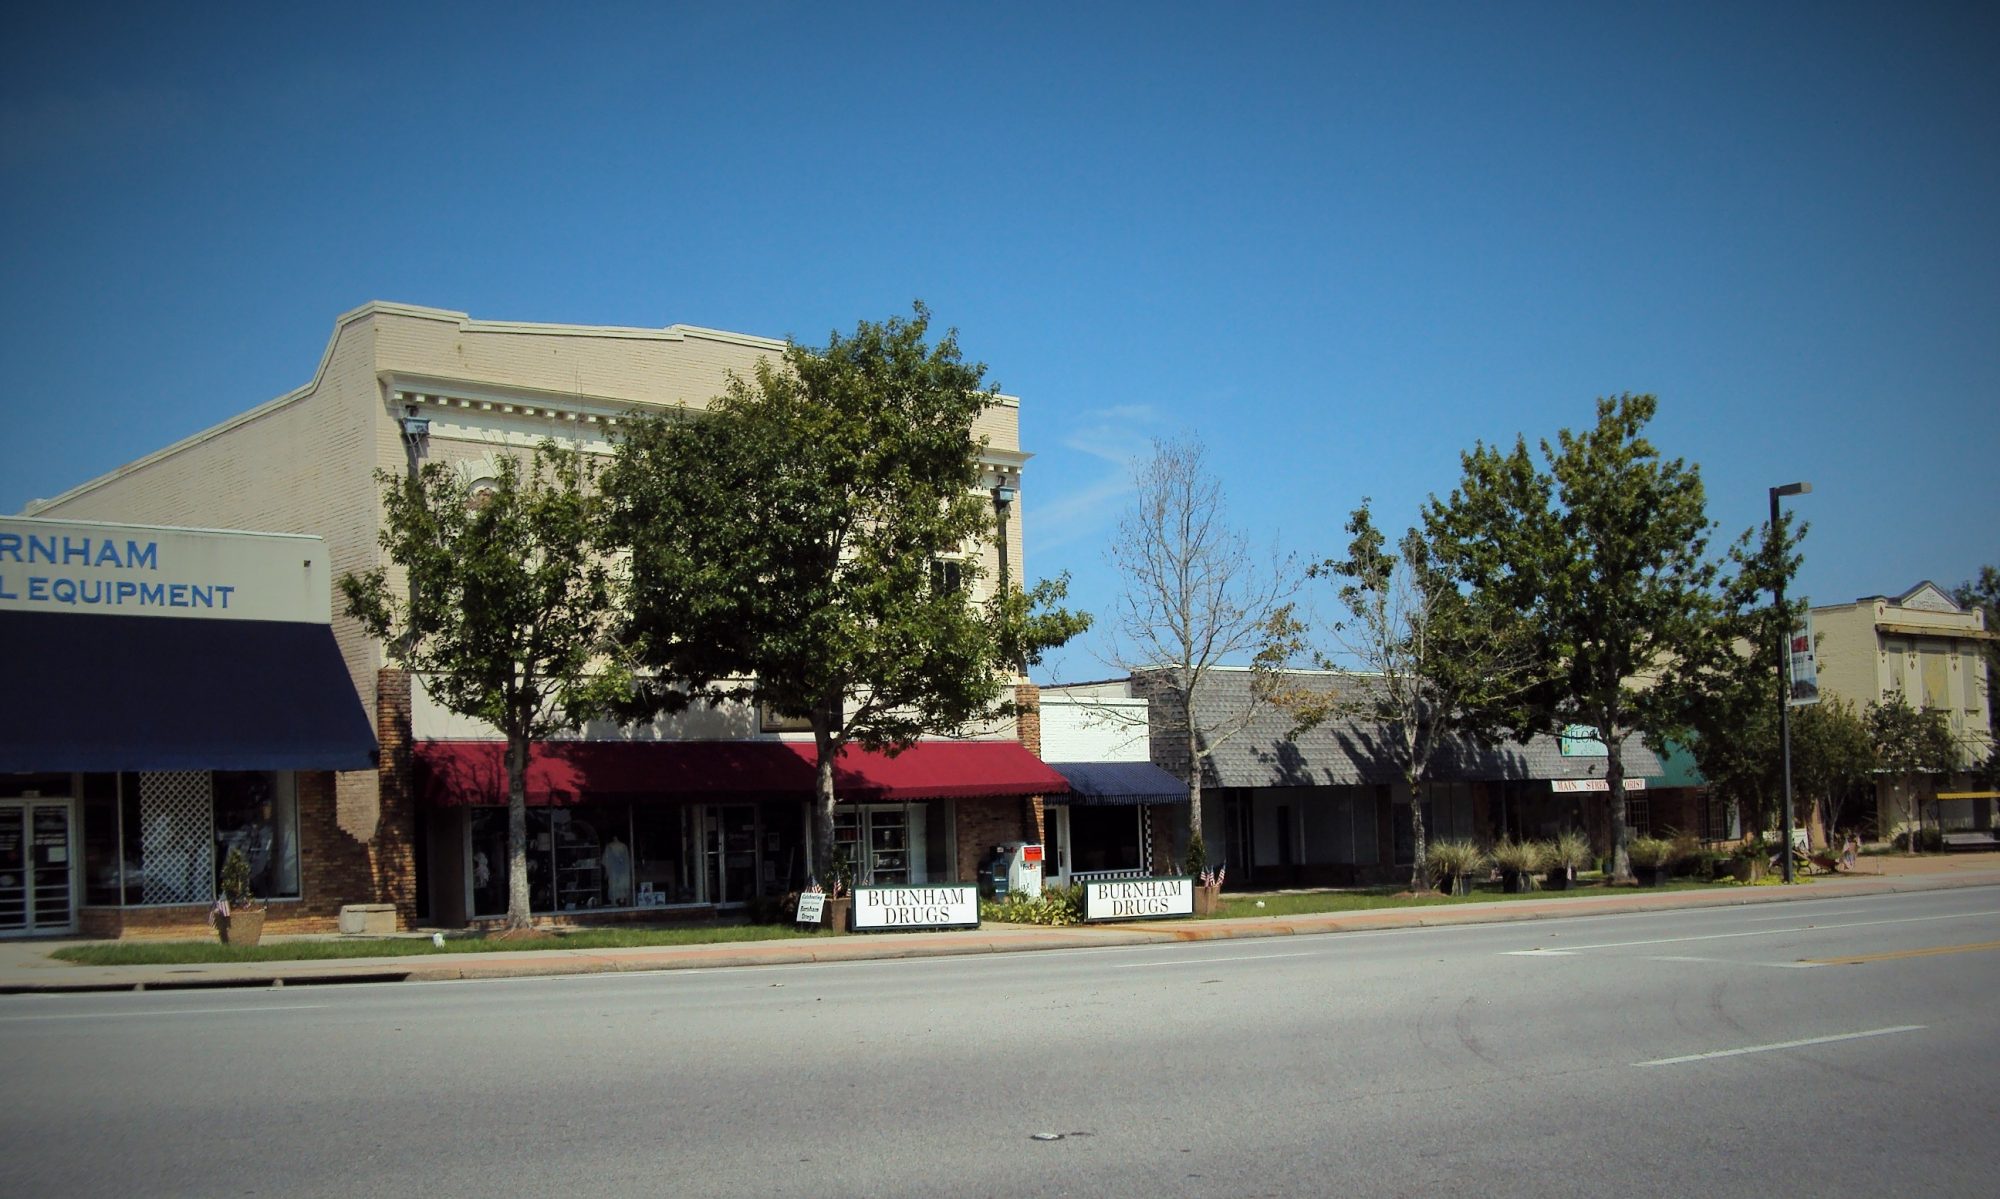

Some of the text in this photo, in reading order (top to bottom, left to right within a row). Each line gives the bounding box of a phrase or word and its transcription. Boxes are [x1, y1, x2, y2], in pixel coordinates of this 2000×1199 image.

[0, 533, 157, 570] RNHAM
[28, 576, 235, 609] EQUIPMENT
[1556, 781, 1577, 791] MAIN
[868, 888, 966, 907] BURNHAM
[1098, 880, 1182, 900] BURNHAM
[884, 906, 951, 925] DRUGS
[1113, 898, 1169, 916] DRUGS
